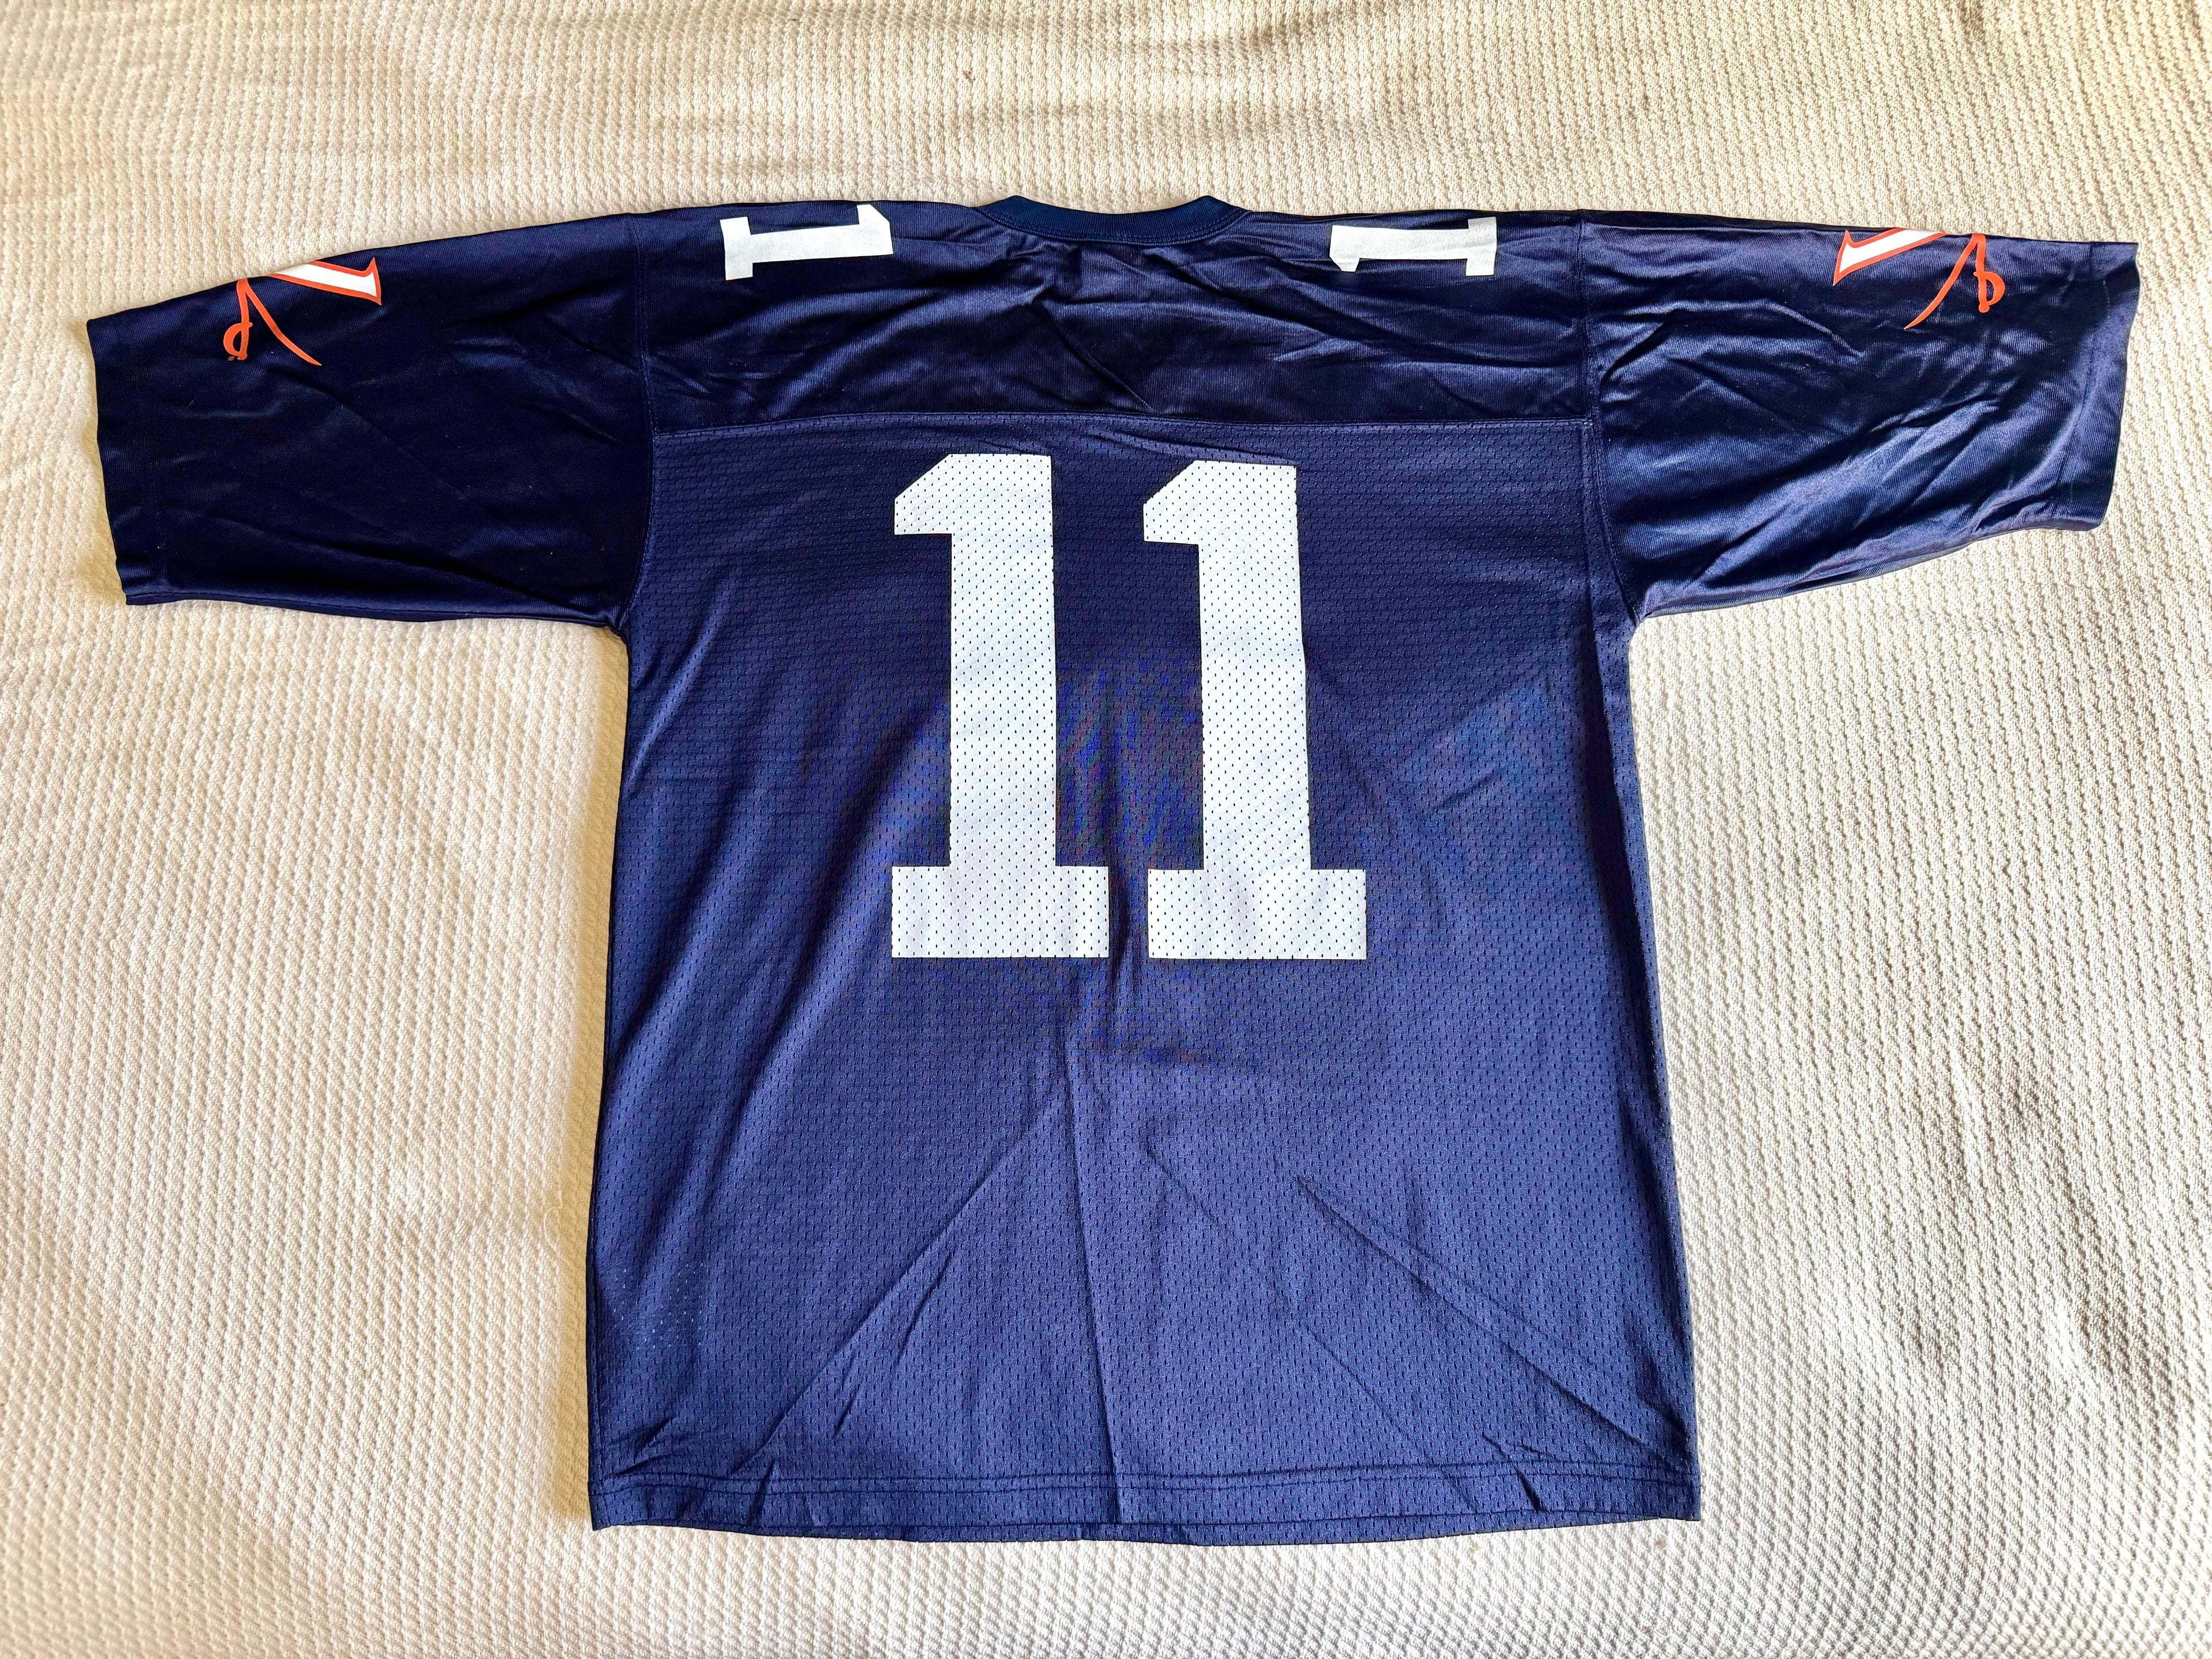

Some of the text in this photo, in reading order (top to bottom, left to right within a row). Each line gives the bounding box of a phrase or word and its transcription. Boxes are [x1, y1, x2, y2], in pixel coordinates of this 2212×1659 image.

[719, 204, 894, 281] 1
[1329, 216, 1497, 276] 1
[891, 453, 1368, 960] 11
